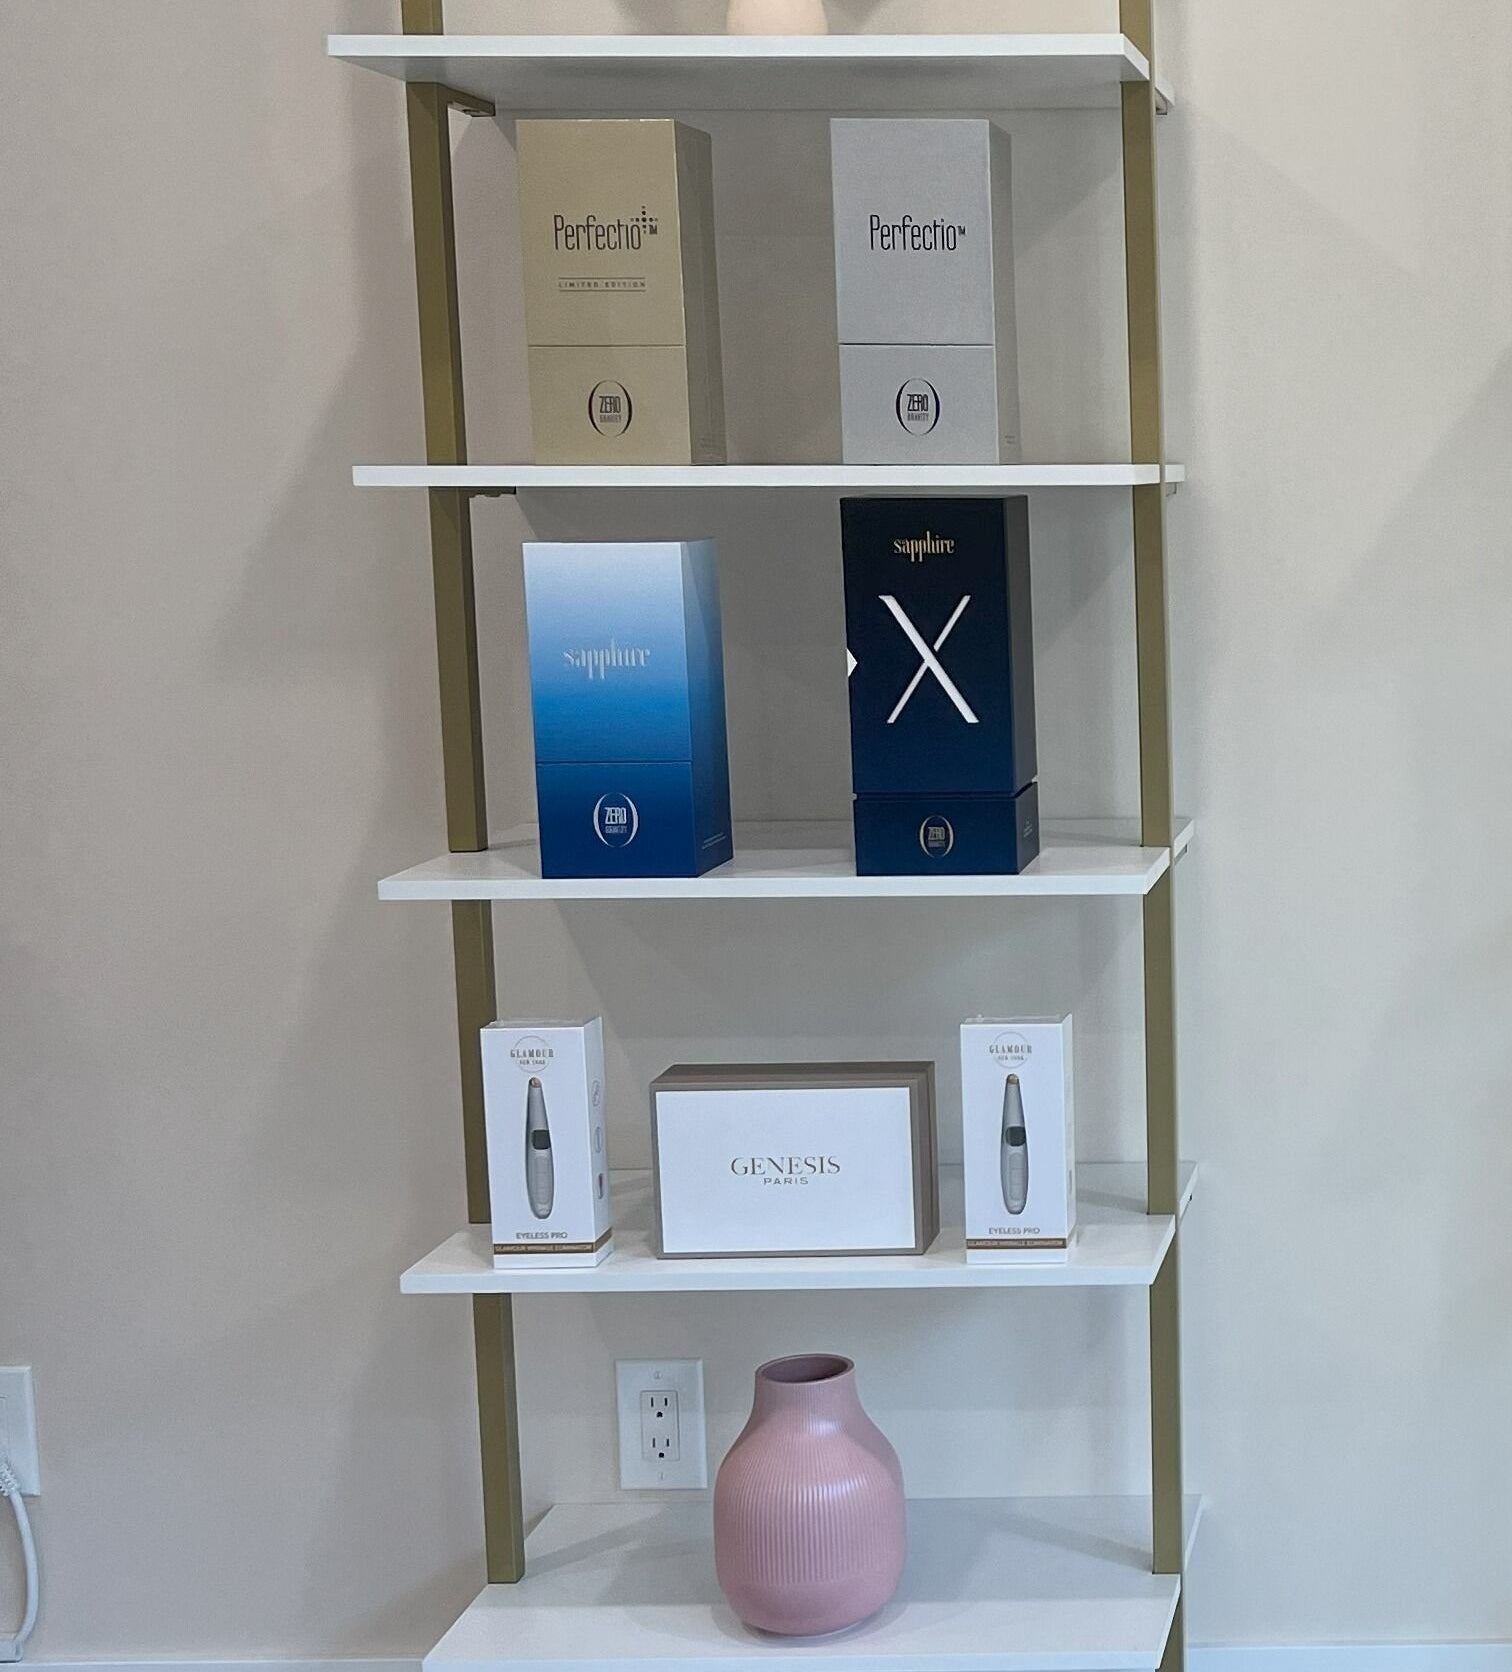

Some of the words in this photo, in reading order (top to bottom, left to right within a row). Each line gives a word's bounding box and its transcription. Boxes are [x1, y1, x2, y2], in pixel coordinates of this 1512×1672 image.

[906, 393, 929, 412] ZERO
[893, 530, 955, 563] sapphire
[878, 595, 980, 723] X
[731, 1156, 841, 1175] GENESIS
[763, 1176, 809, 1185] PARIS
[516, 1231, 549, 1240] EYELESS
